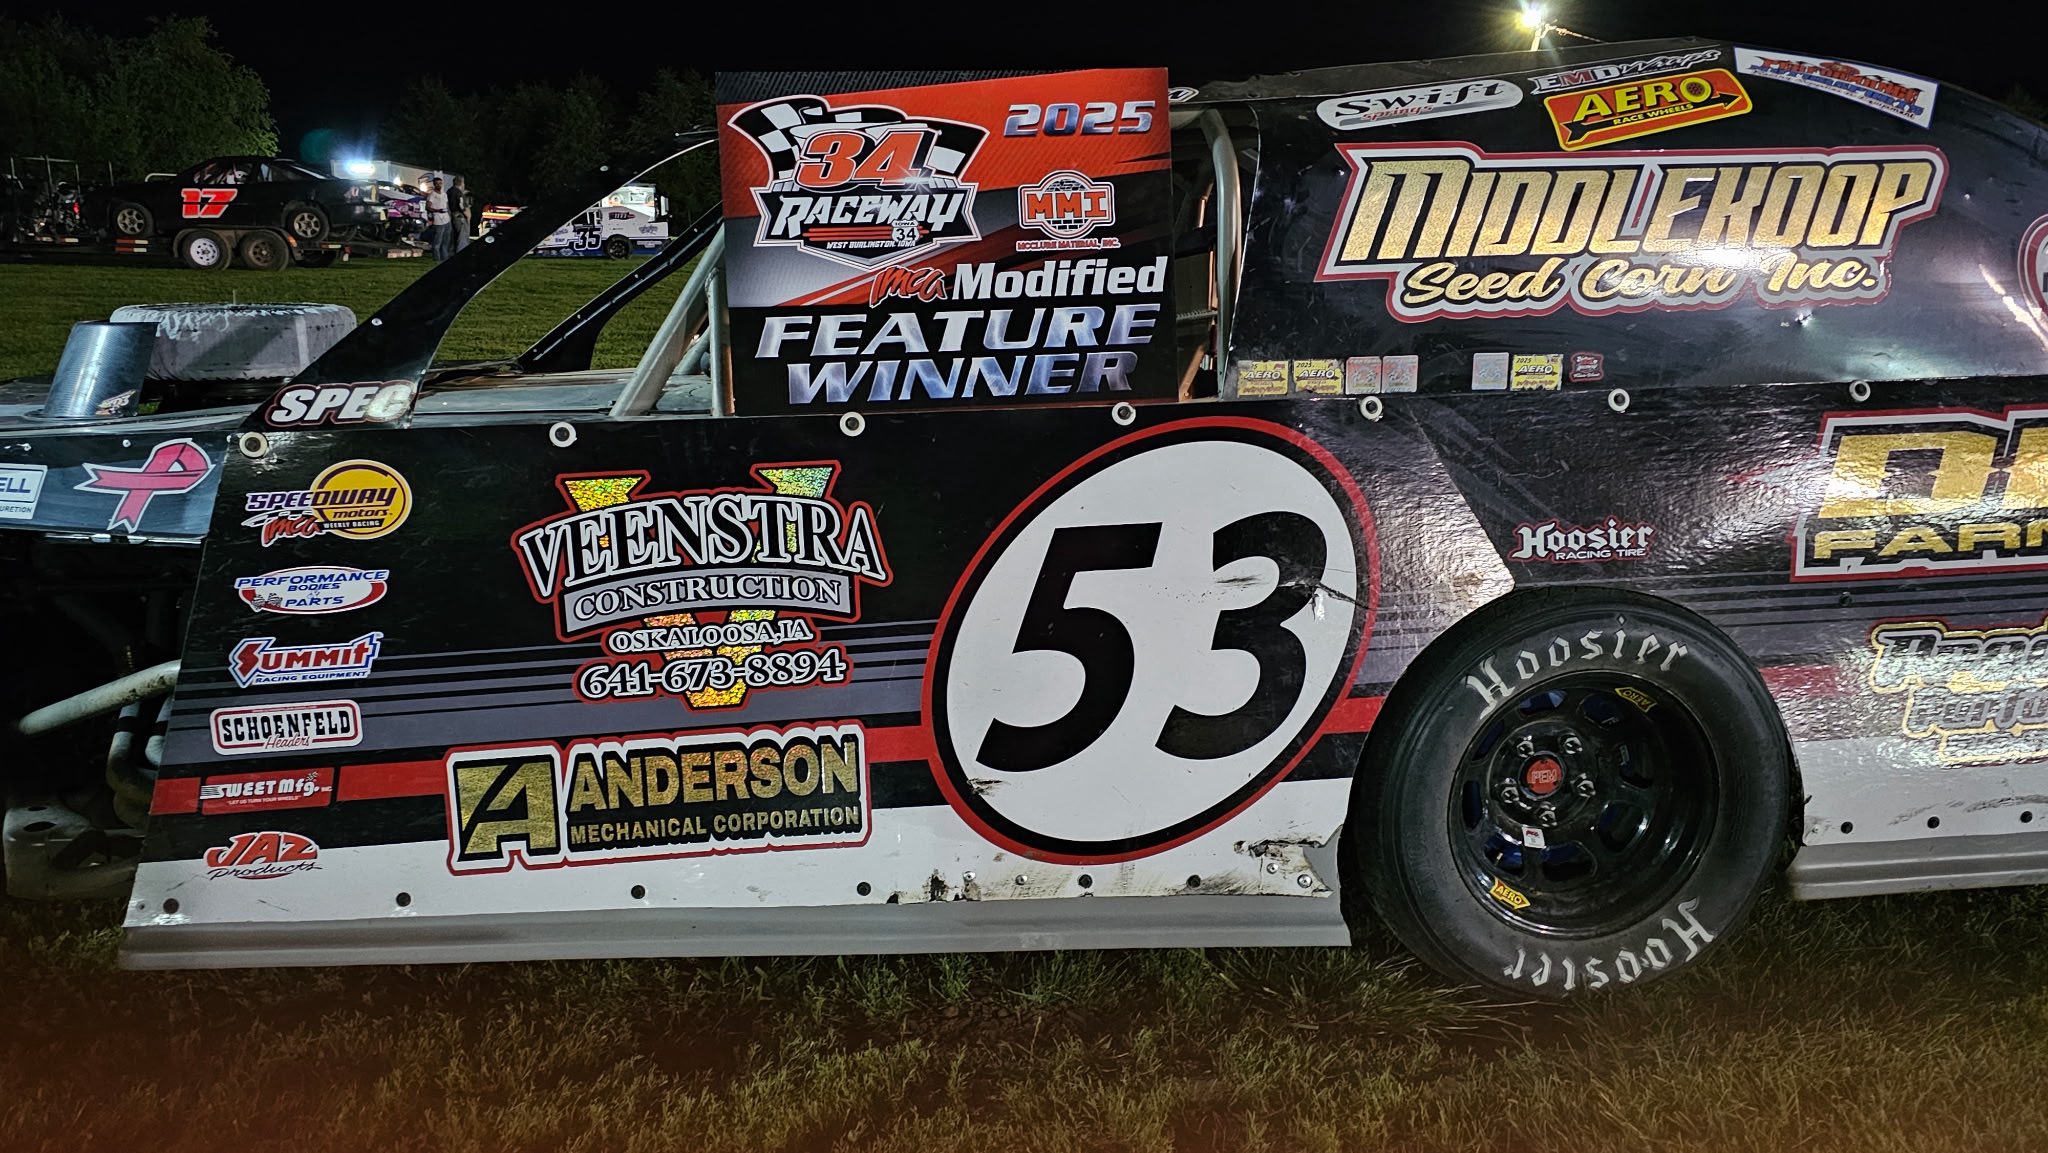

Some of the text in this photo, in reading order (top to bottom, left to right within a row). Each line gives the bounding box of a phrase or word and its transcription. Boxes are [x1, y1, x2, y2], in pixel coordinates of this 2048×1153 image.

[1335, 82, 1504, 118] Swift
[1573, 77, 1712, 122] AERO
[1612, 103, 1694, 125] RACE WHEELS
[1003, 100, 1156, 136] 2025
[796, 129, 925, 190] 34
[181, 188, 238, 218] 17
[1026, 191, 1108, 220] MMI
[896, 228, 917, 241] 34
[952, 256, 1169, 301] Modified
[1401, 250, 1877, 303] Seed Corn Inc.
[754, 303, 1161, 359] FEATURE
[786, 351, 1139, 404] WINNER
[1300, 369, 1335, 379] AERO
[1519, 364, 1554, 374] AERO
[271, 384, 412, 422] SPEC
[245, 488, 398, 511] SPEEDWAY
[352, 519, 380, 528] RACING
[1511, 518, 1655, 559] Hoosier
[1814, 518, 2048, 560] FAR
[518, 493, 887, 598] VEENSTRA
[1556, 548, 1647, 560] RACING TIRE
[237, 570, 388, 588] PERFORMANCE
[287, 582, 342, 592] BODIES
[285, 596, 345, 608] PARTS
[574, 574, 842, 621] CONSTRUCTION
[974, 510, 1328, 773] 53
[255, 671, 368, 684] RACING EQUIPMENT
[579, 647, 848, 699] 641-673-8894
[1462, 616, 1689, 720] Hoosier
[221, 709, 351, 743] SCHOENFELD
[265, 731, 311, 750] Headers
[568, 740, 860, 813] ANDERSON
[569, 805, 860, 845] MECHANICAL CORPORATION
[206, 832, 319, 868] JAZ
[1496, 882, 1523, 905] AERO
[1504, 897, 1715, 991] Hoosier
